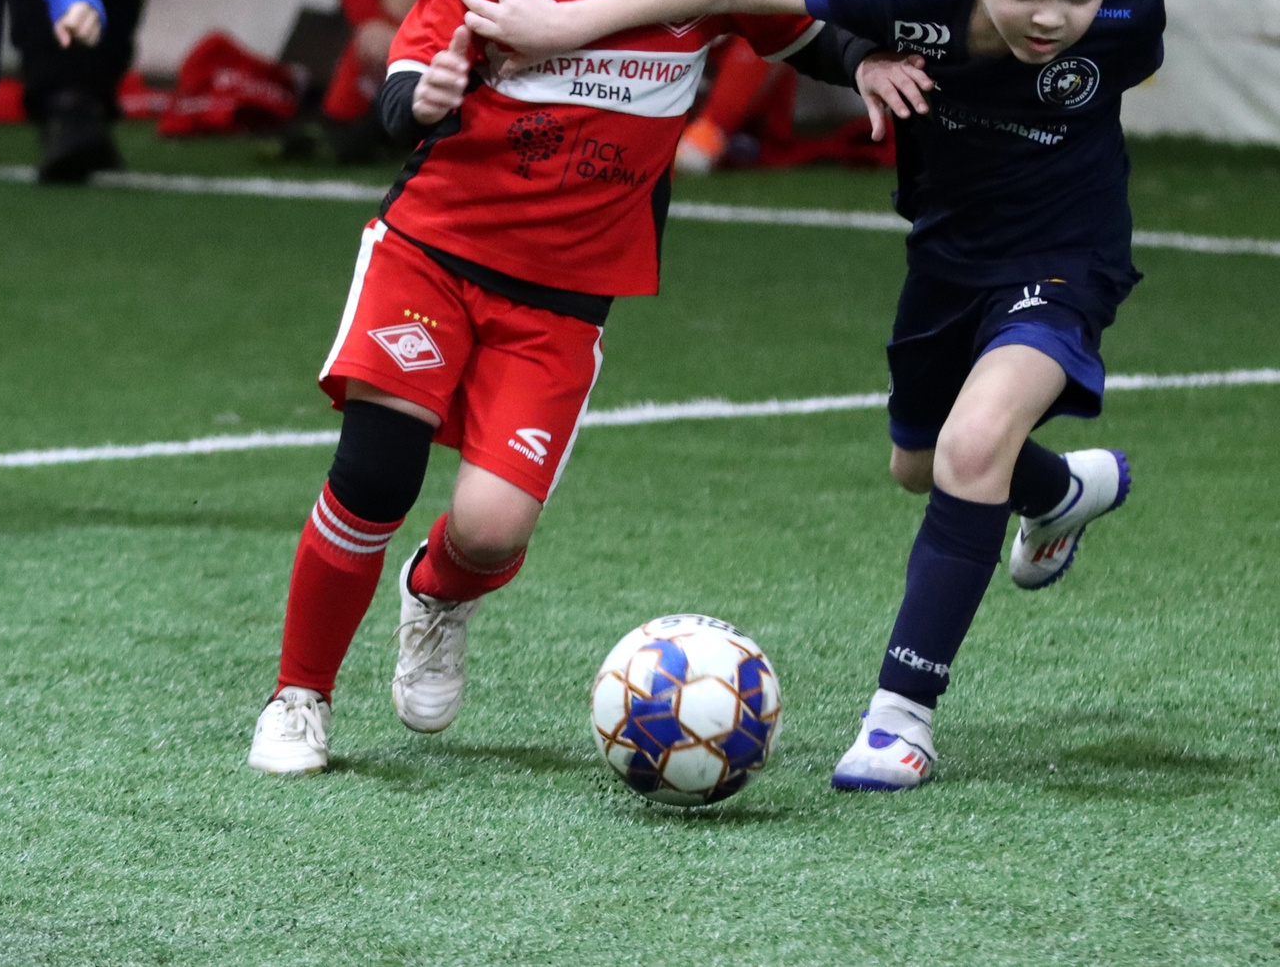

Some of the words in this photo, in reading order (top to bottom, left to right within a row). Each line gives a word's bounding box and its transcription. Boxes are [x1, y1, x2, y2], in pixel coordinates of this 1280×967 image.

[619, 59, 692, 83] ЮНИОР
[569, 81, 632, 103] ДУБНА
[582, 138, 628, 164] ПСК
[576, 161, 648, 187] ФАРМА
